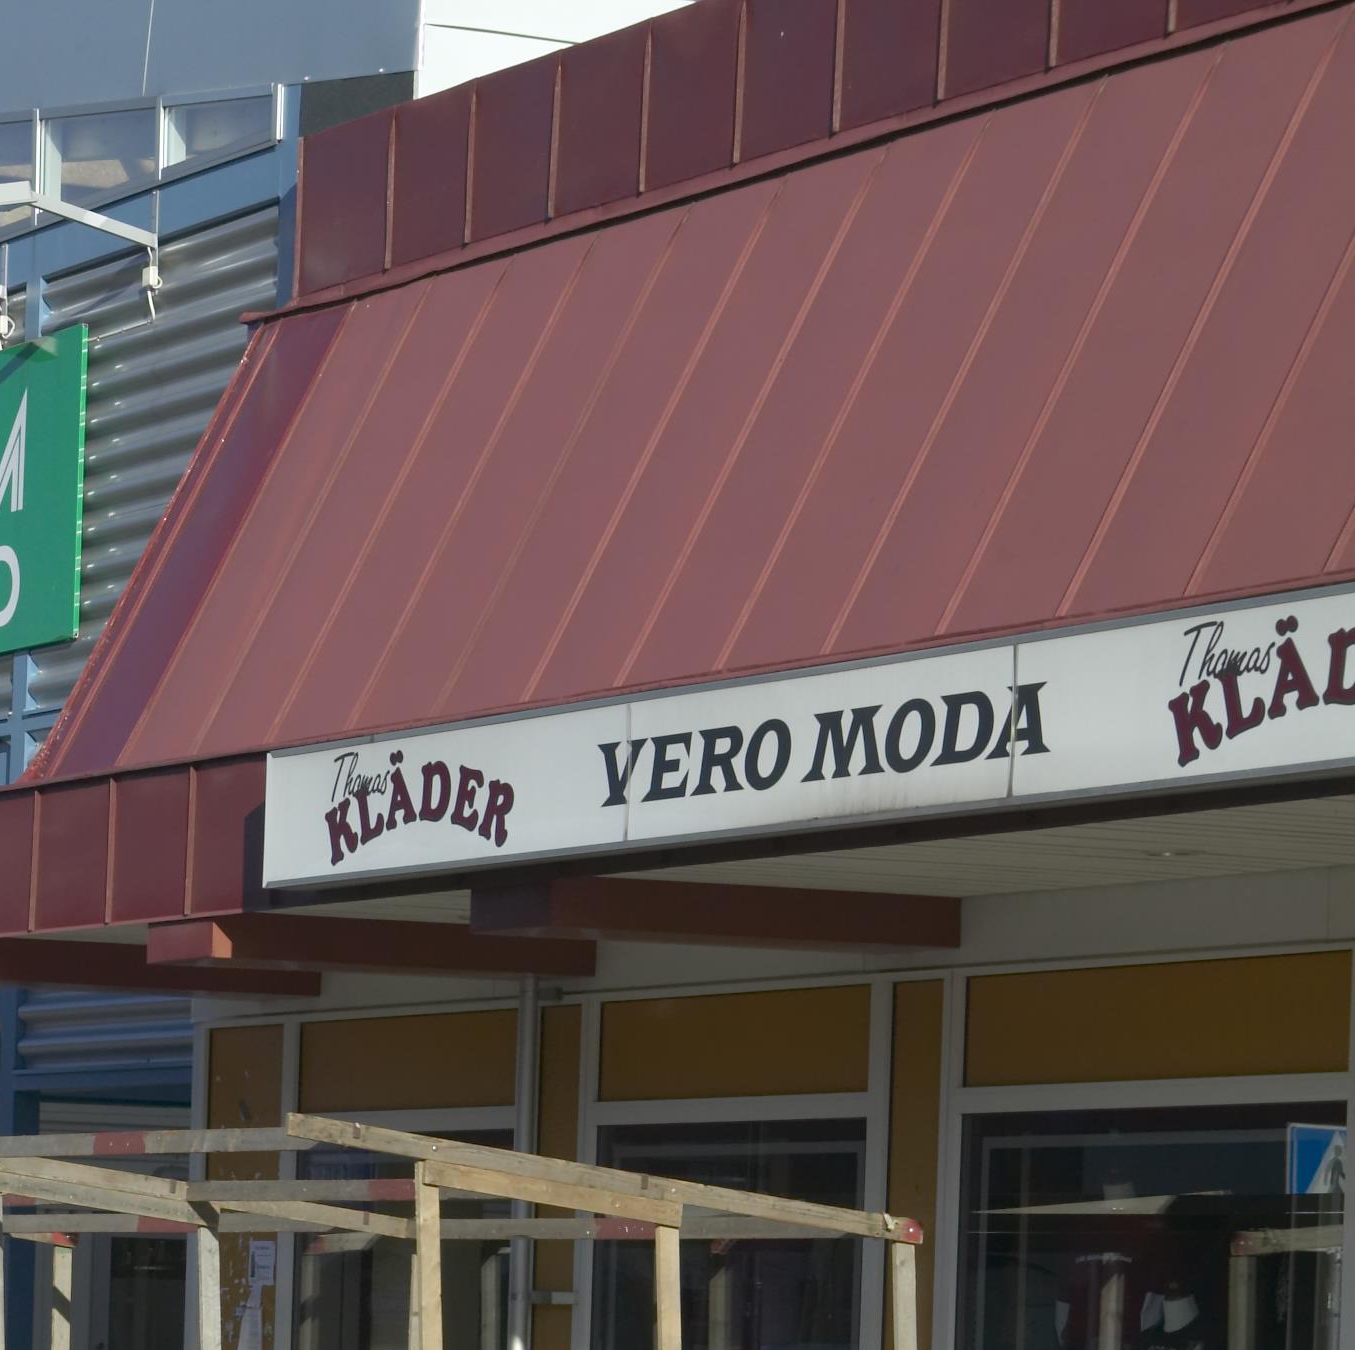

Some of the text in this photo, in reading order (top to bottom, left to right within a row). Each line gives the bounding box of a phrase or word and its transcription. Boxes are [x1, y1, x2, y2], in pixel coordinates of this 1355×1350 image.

[1179, 620, 1277, 687] Thomas
[332, 751, 390, 803] Thomas
[598, 681, 1051, 808] VERO MODA
[325, 750, 515, 866] KLÄDER
